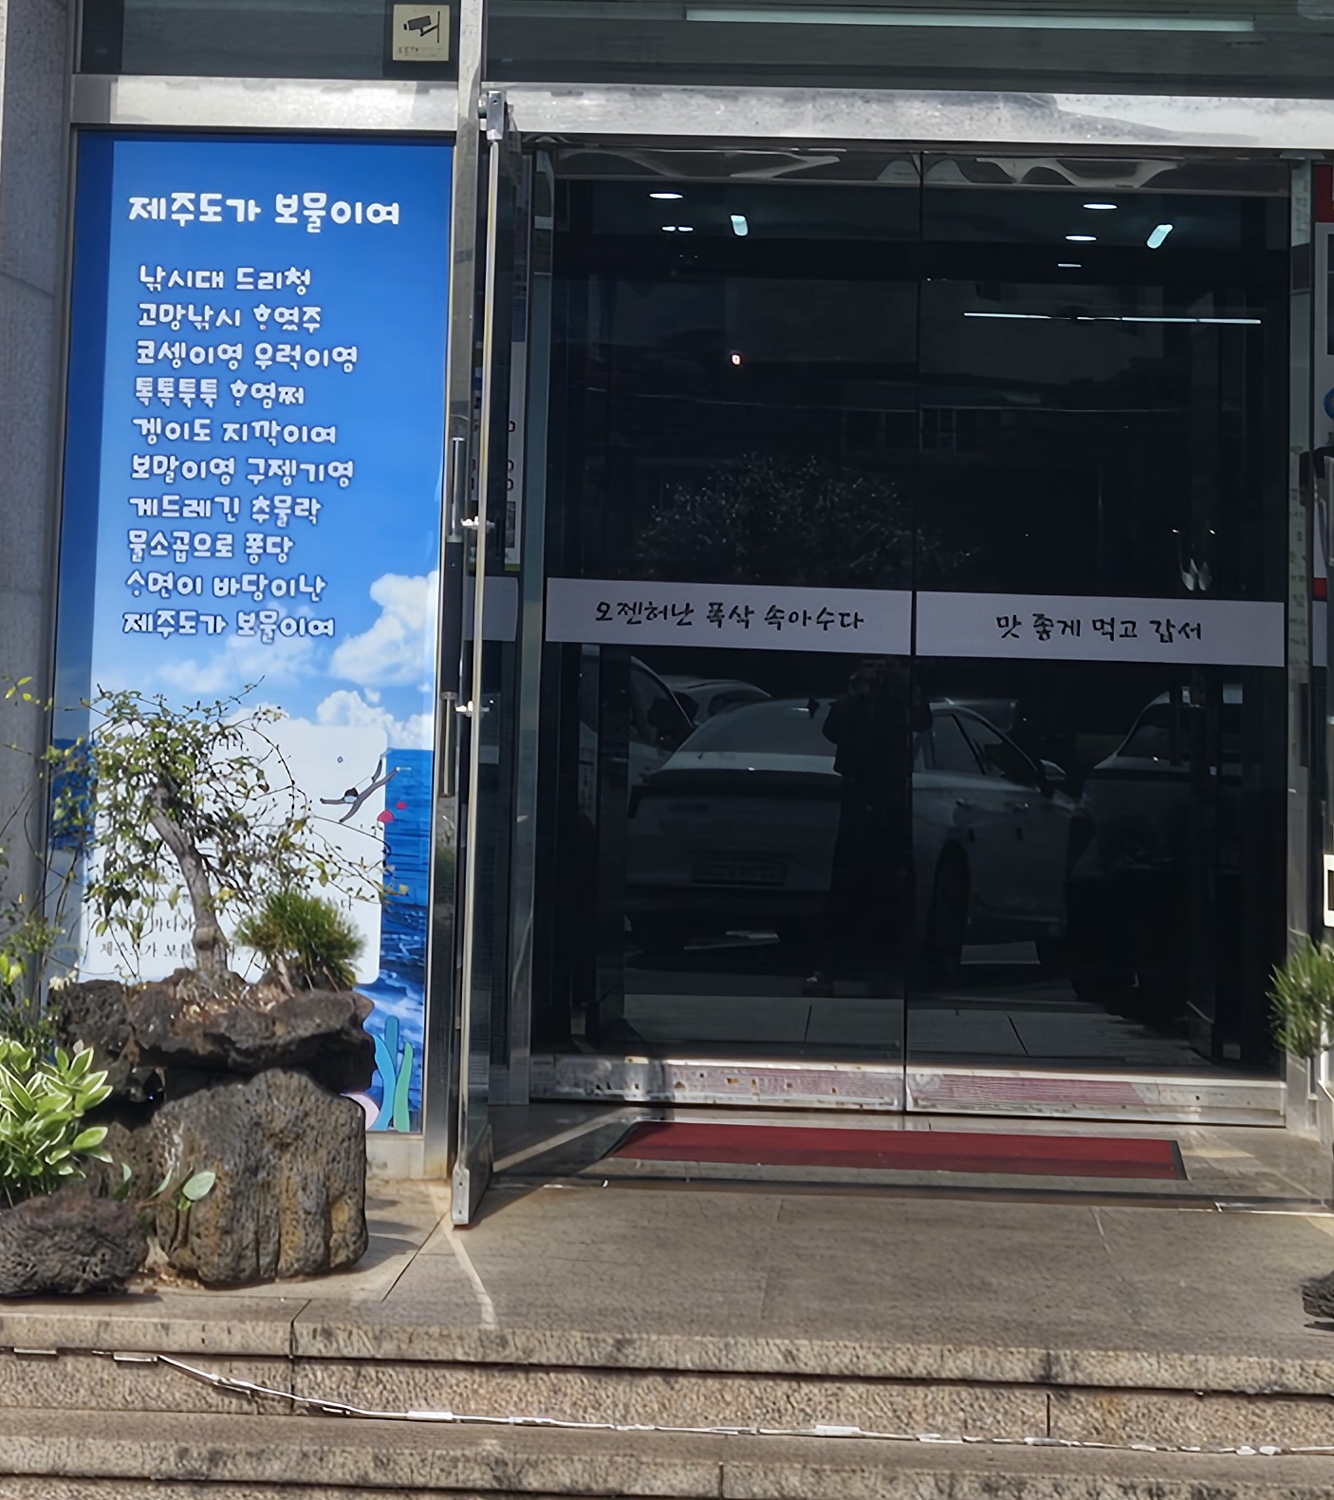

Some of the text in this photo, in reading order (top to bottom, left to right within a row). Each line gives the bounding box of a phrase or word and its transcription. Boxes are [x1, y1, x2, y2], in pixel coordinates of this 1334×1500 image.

[127, 190, 401, 235] 제주도가 보물이여
[138, 264, 312, 296] 낚시대 드리청
[137, 302, 242, 331] 고망낚시
[135, 340, 359, 374] 코셍이영 우럭이영
[131, 417, 338, 447] 겡이도 지깍이여
[130, 453, 355, 489] 보말이영 구젱기영
[128, 493, 240, 523] 게드레긴
[244, 531, 296, 566] 퐁당
[212, 572, 328, 603] 바당이난
[121, 609, 336, 645] 제주도가 보물이여
[706, 601, 756, 630] 폭삭
[764, 604, 866, 632] 속아수다
[995, 613, 1023, 640] 맛
[1091, 616, 1139, 643] 먹고
[1149, 617, 1203, 644] 갑서
